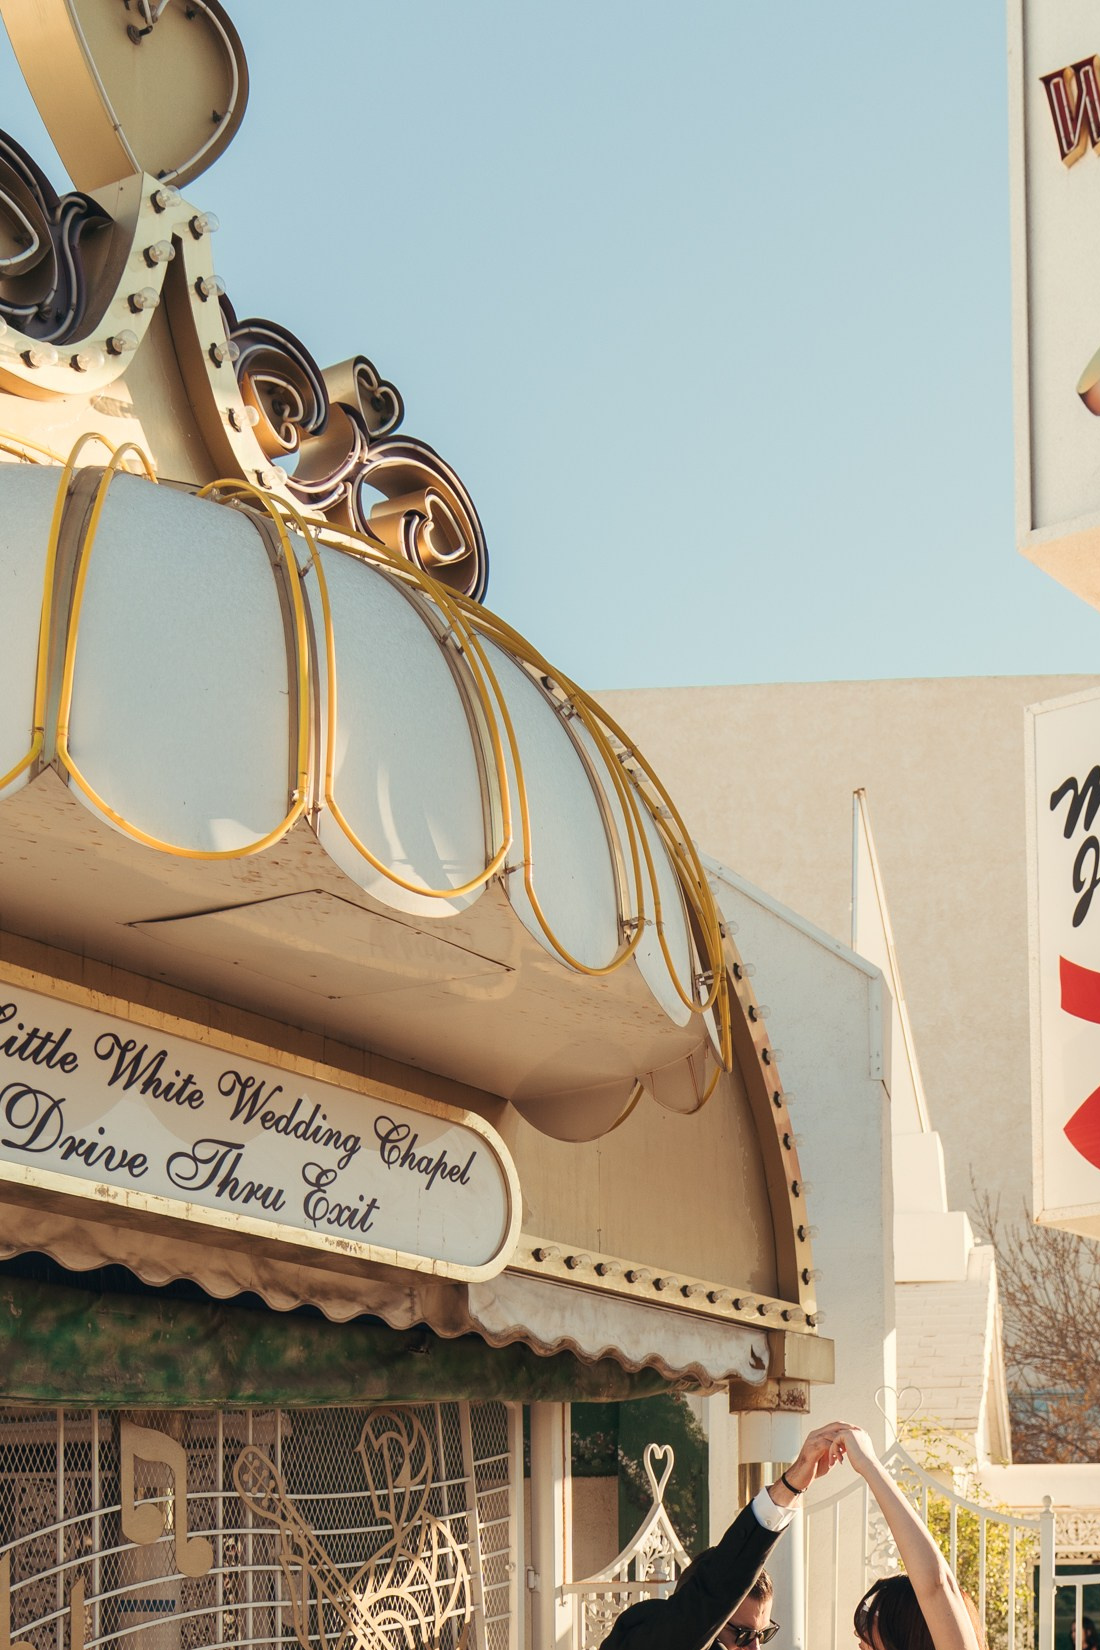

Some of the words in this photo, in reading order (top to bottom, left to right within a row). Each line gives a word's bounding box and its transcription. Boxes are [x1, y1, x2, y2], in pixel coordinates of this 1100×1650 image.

[0, 1082, 149, 1178] Drive
[166, 1138, 286, 1211] Thru
[302, 1161, 380, 1233] Exit
[94, 1032, 205, 1109] White
[218, 1070, 361, 1169] Wedding
[373, 1115, 477, 1190] Chapel
